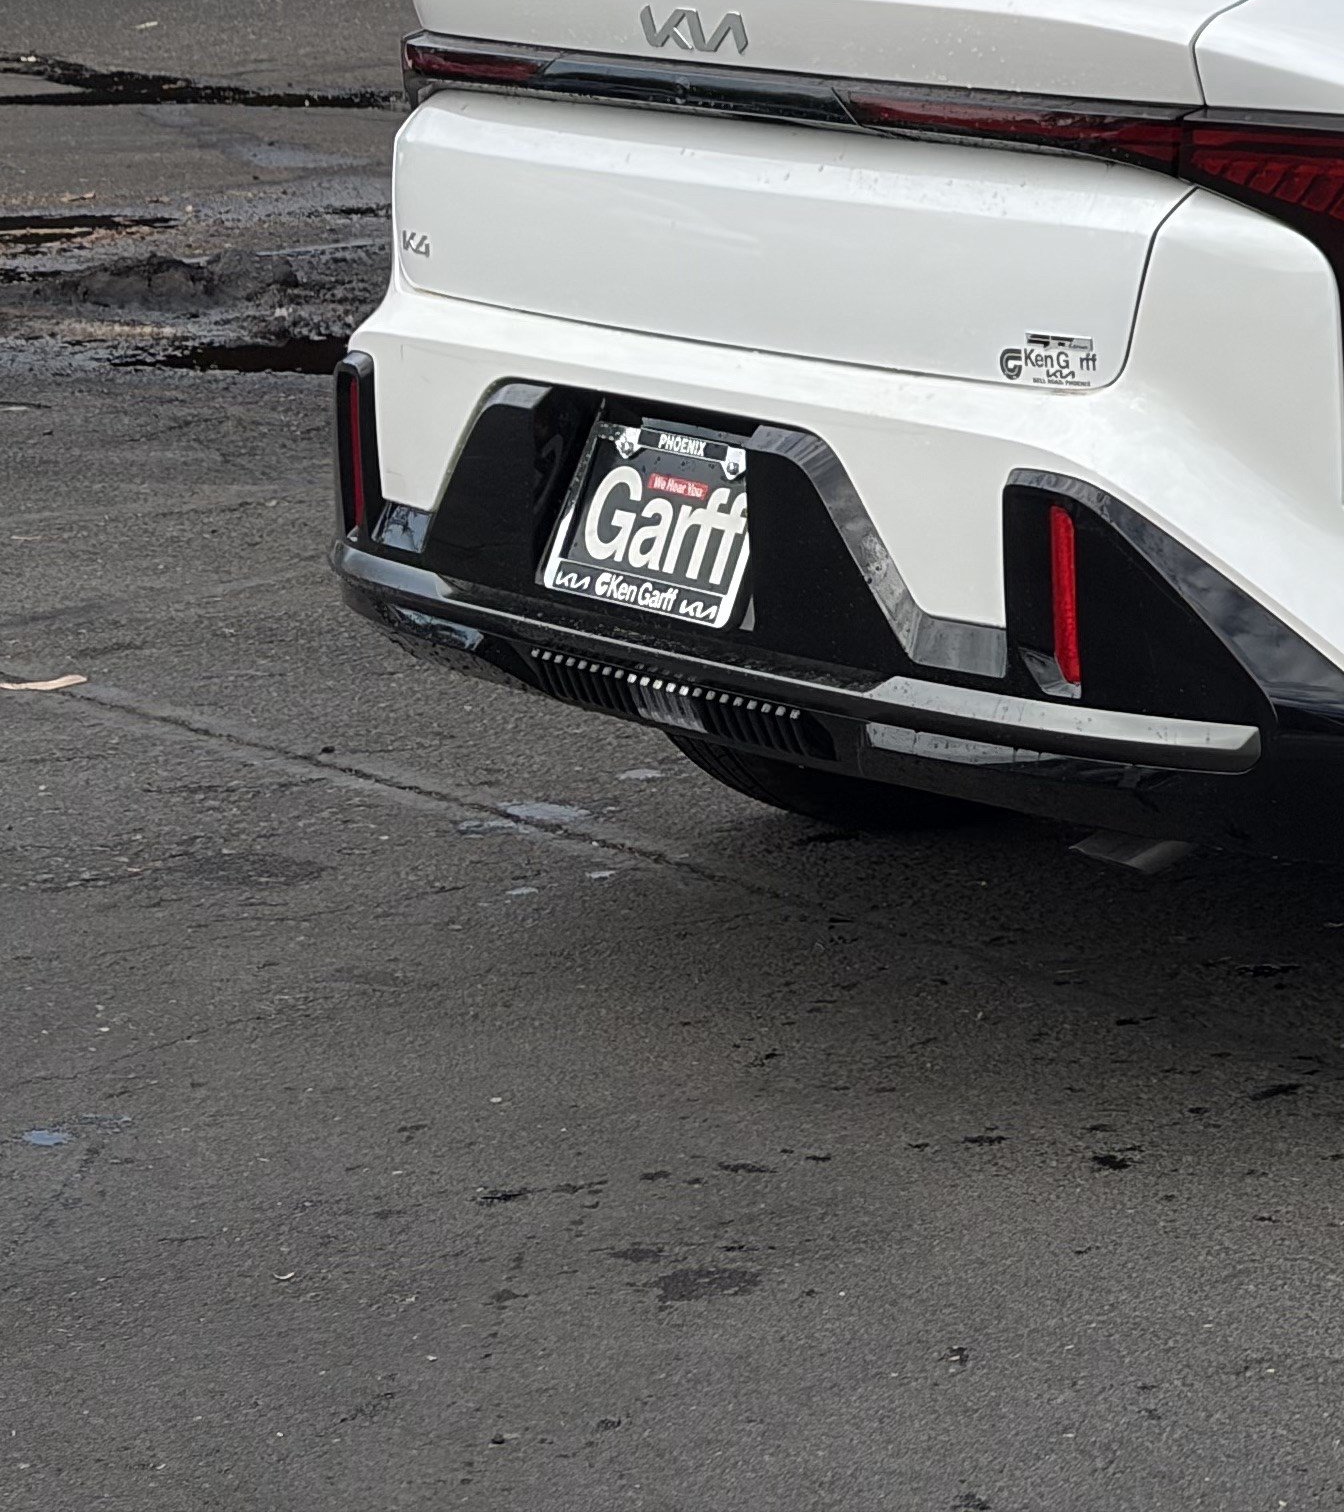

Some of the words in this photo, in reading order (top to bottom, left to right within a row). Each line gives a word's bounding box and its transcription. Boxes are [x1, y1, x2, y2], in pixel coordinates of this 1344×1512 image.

[640, 3, 749, 54] KIA
[402, 230, 430, 258] K4
[1024, 348, 1054, 369] Ken
[1057, 351, 1097, 371] Grff
[1046, 369, 1075, 379] KIA
[658, 433, 706, 457] PHOENIX
[653, 476, 666, 490] We
[667, 478, 687, 494] Hear
[584, 465, 747, 584] Garff
[555, 570, 590, 590] KIA
[607, 573, 636, 603] Ken
[637, 582, 677, 611] Garff
[680, 599, 717, 619] KIA
